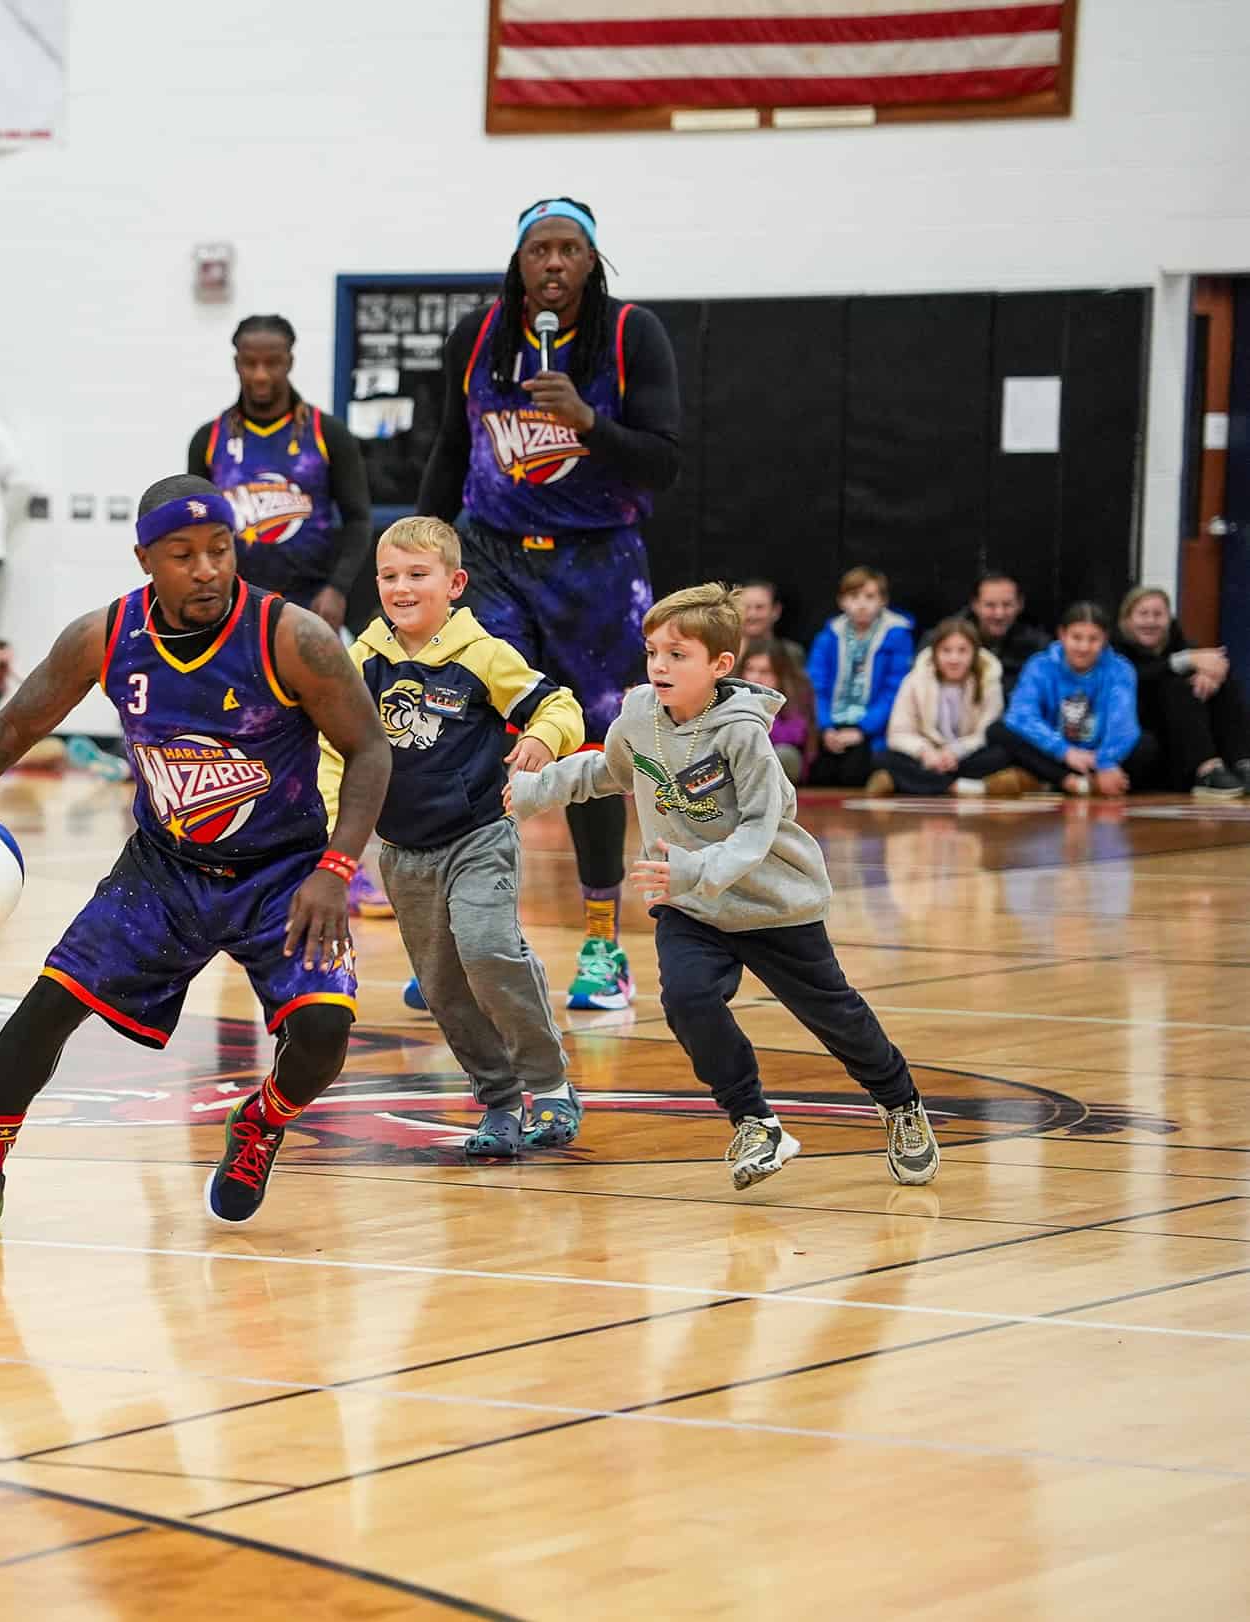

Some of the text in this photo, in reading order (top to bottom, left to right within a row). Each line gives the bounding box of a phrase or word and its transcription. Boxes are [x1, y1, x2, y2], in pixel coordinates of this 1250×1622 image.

[483, 410, 581, 466] WIZAR
[126, 673, 150, 715] 3
[164, 747, 225, 760] HARLEM
[135, 745, 269, 819] WIZARDS
